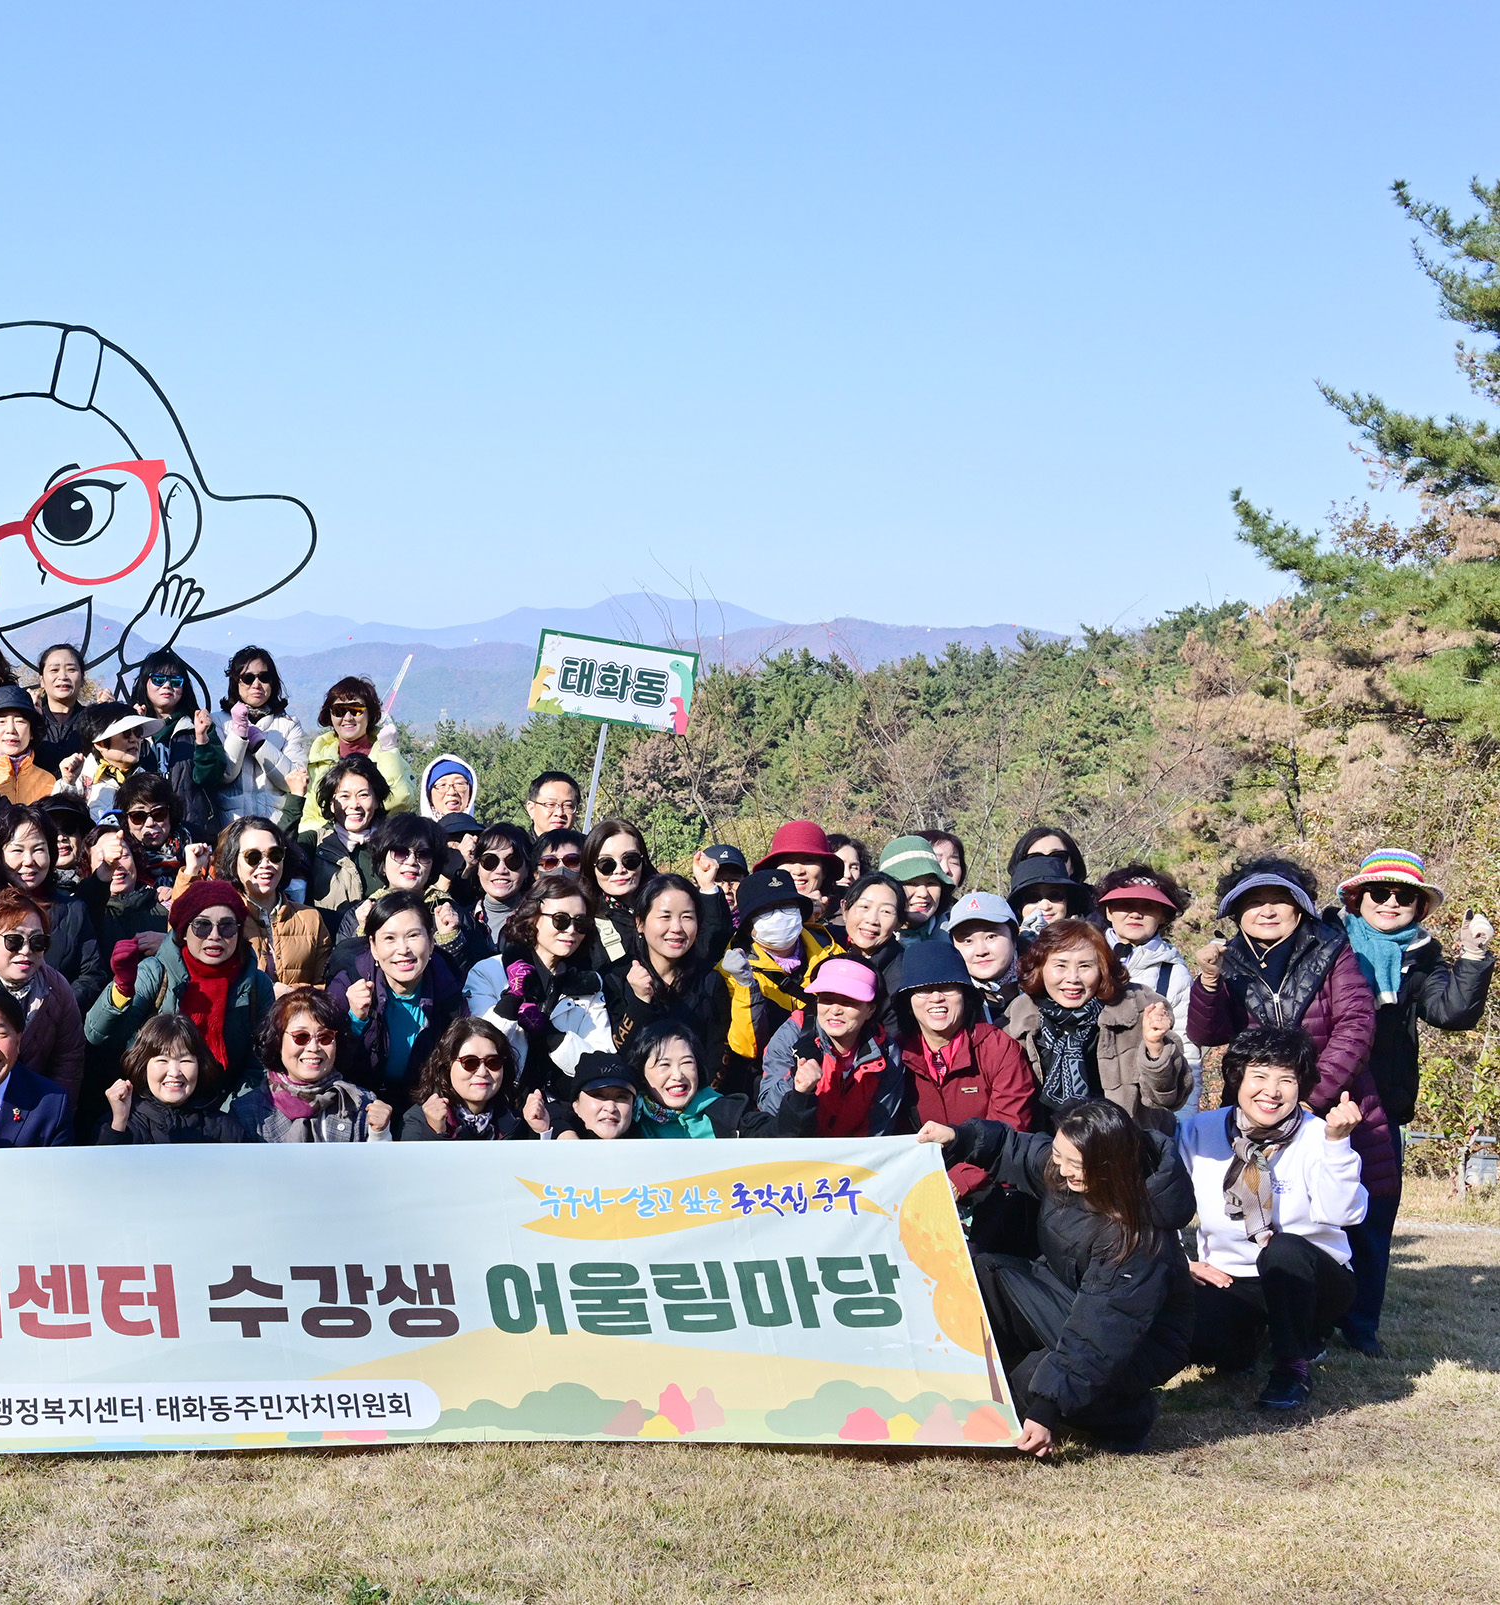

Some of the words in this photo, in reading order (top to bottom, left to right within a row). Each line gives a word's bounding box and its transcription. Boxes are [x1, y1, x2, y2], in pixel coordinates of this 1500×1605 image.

[559, 658, 669, 707] 태화동
[539, 1184, 614, 1217] 누구나
[619, 1184, 672, 1217] 살고
[680, 1186, 722, 1214] 싶은
[731, 1182, 808, 1217] 종갓집
[812, 1177, 863, 1216] 중구
[208, 1264, 460, 1339] 수강생
[486, 1254, 903, 1336] 어울림마당
